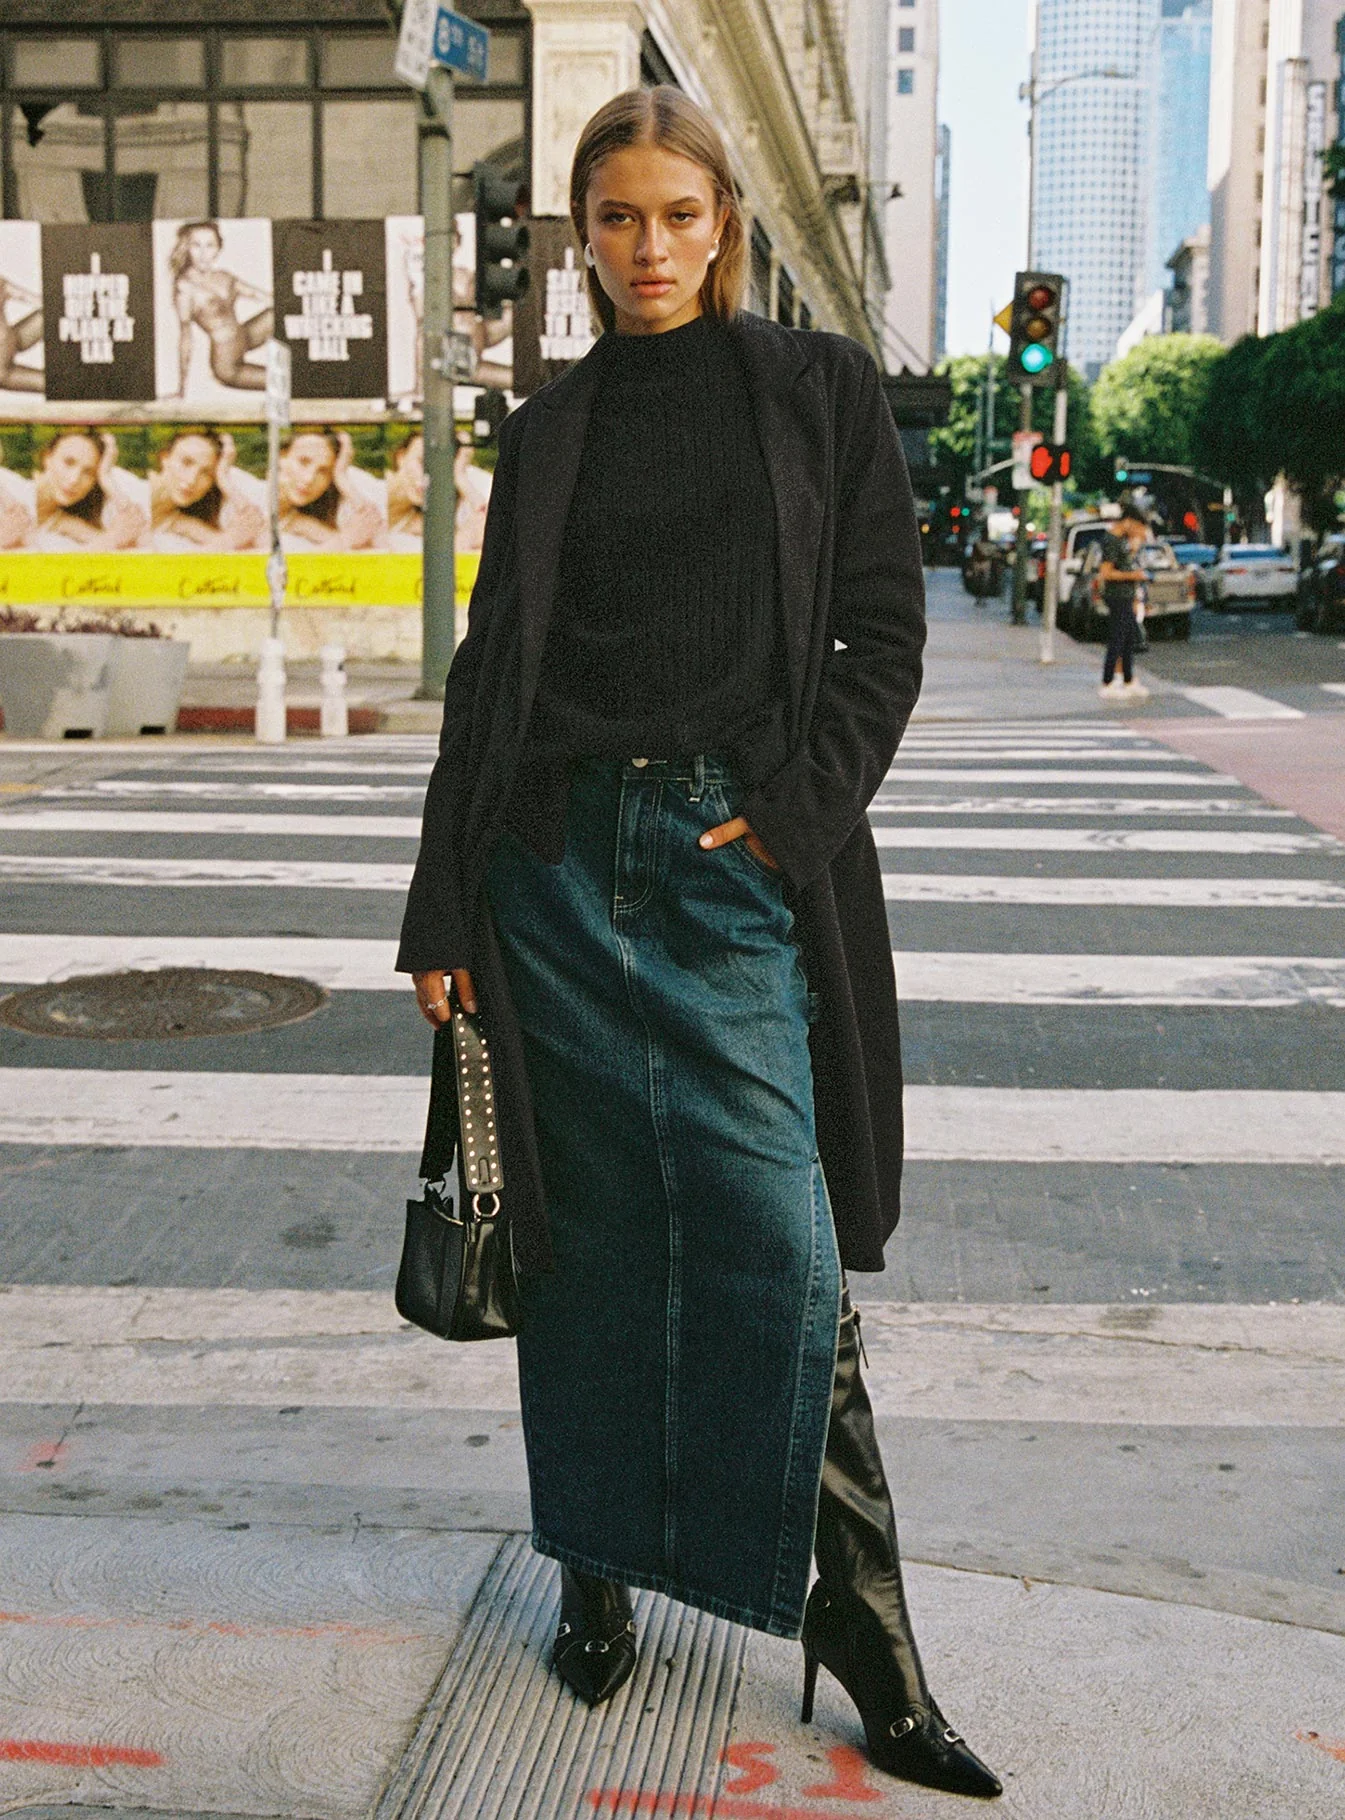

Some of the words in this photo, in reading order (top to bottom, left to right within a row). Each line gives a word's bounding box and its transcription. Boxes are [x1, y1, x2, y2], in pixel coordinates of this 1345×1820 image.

[90, 252, 101, 274] I
[322, 248, 332, 271] I
[565, 246, 574, 269] I
[293, 271, 340, 295] CAME
[342, 271, 363, 295] IN
[302, 295, 337, 315] LIKE
[341, 295, 355, 315] A
[58, 317, 110, 342] PLANE
[112, 317, 135, 342] AT
[284, 315, 373, 339] WRECKING
[309, 338, 350, 361] BALL
